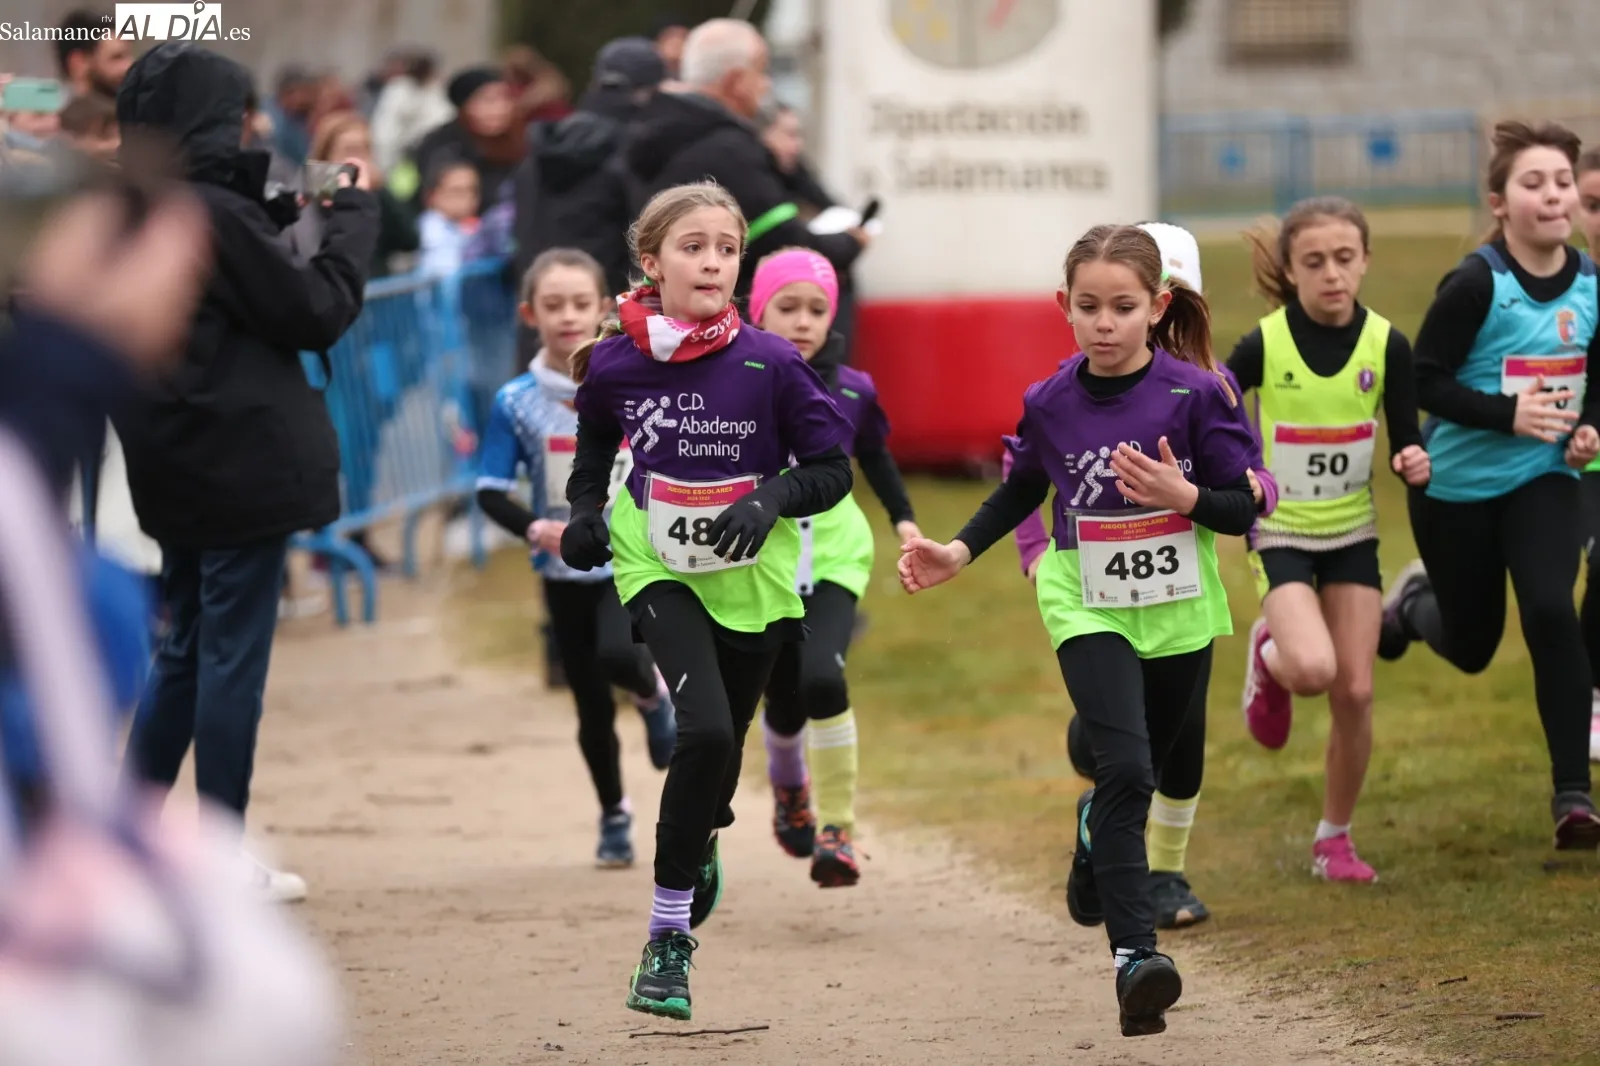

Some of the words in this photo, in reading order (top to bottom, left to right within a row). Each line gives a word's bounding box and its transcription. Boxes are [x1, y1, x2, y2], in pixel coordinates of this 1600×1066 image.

[677, 393, 706, 411] C.D.
[679, 415, 757, 439] Abadengo
[678, 439, 740, 462] Running
[1306, 453, 1349, 477] 50
[667, 486, 691, 495] JUEGOS
[692, 486, 733, 495] ESCOLARES
[1128, 517, 1169, 529] ESCOLARES
[1104, 545, 1180, 581] 483
